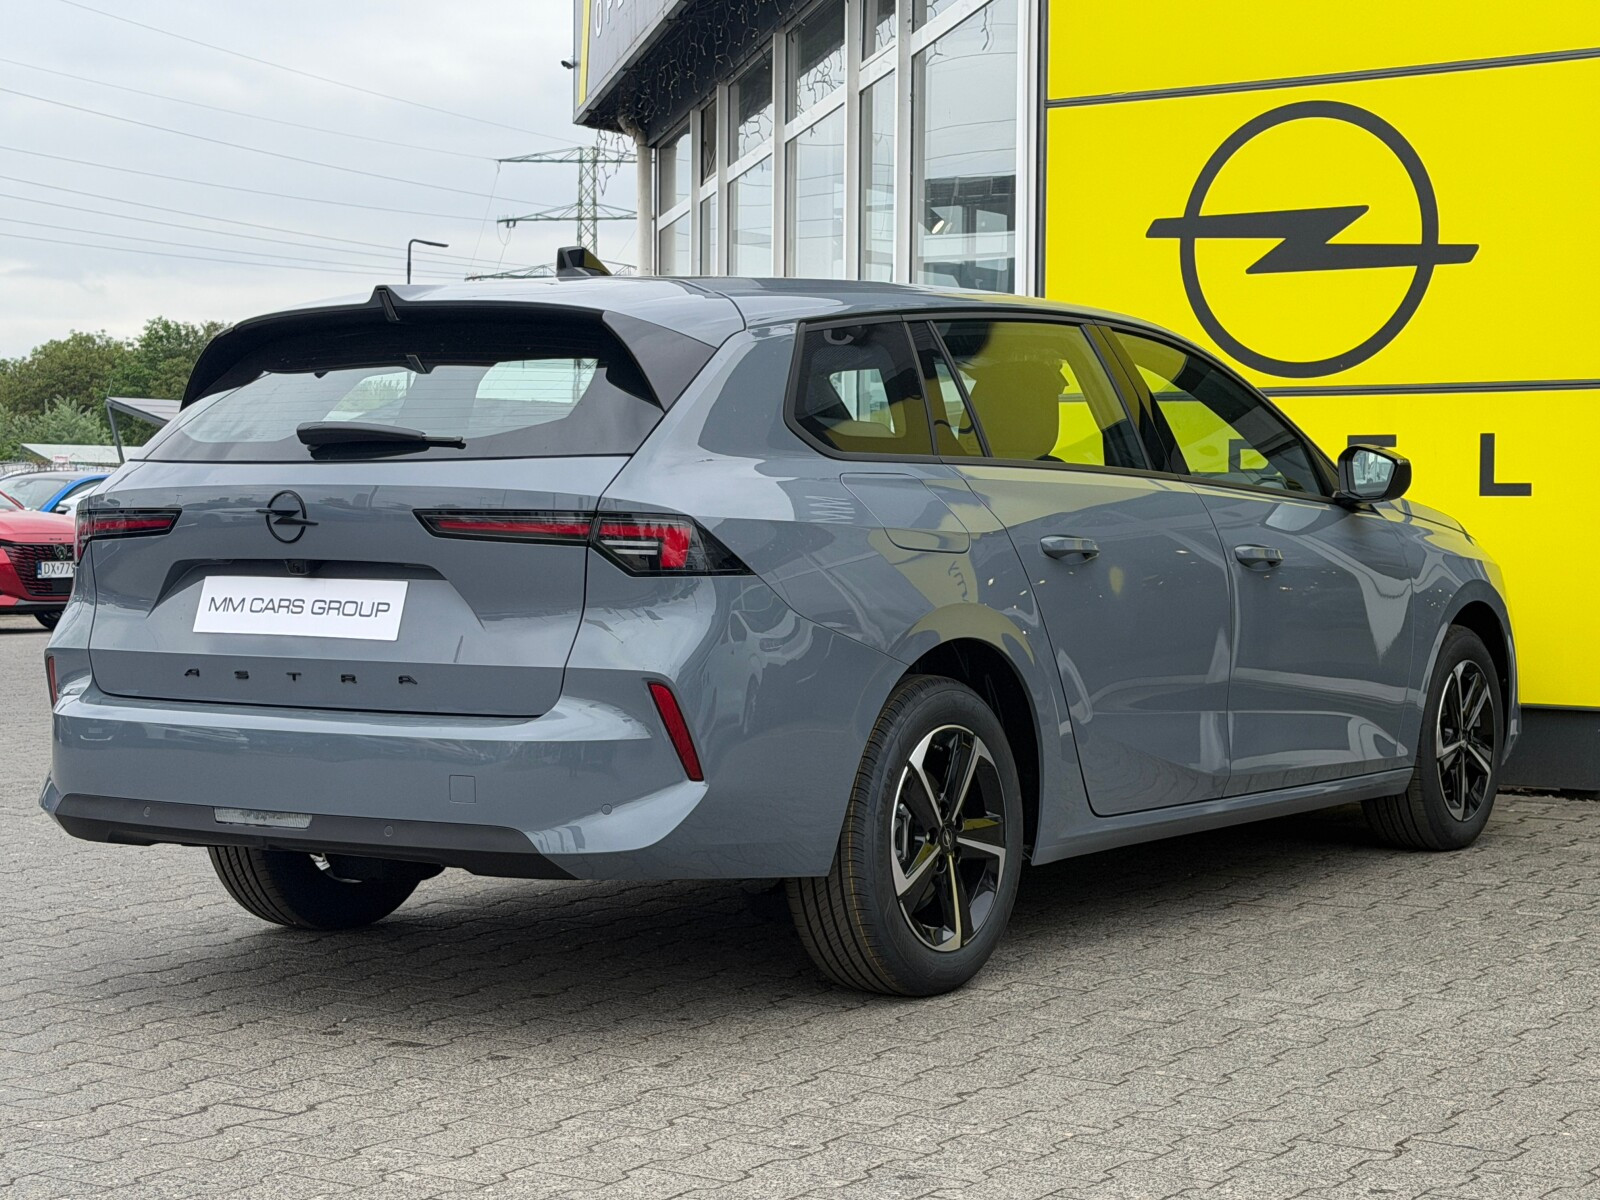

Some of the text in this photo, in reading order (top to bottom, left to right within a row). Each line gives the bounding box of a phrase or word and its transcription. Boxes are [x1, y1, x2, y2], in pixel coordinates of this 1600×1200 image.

[595, 0, 625, 38] OP
[44, 562, 56, 575] DX
[208, 596, 391, 618] MM CARS GROUP
[184, 668, 418, 685] ASTRA
